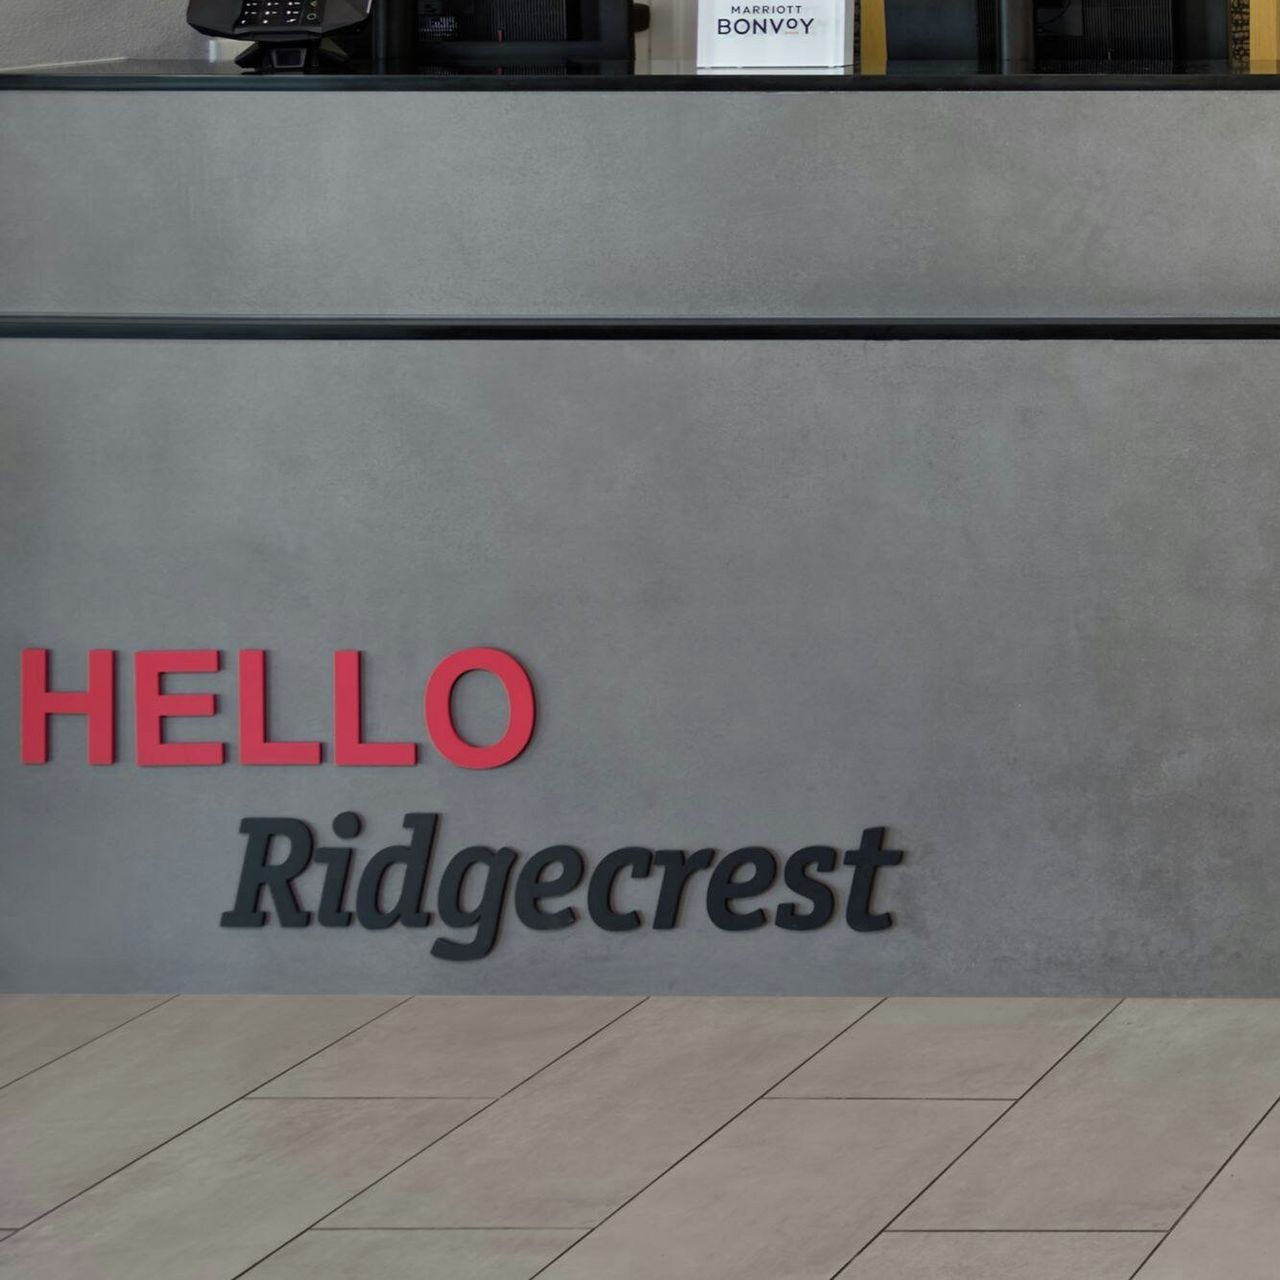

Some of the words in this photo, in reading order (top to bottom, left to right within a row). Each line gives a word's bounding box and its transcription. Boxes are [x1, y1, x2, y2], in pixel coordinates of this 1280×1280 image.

[716, 17, 815, 35] BONVOY
[731, 5, 802, 15] MARRIOTT
[20, 646, 537, 770] HELLO
[220, 809, 905, 962] Ridgecrest
